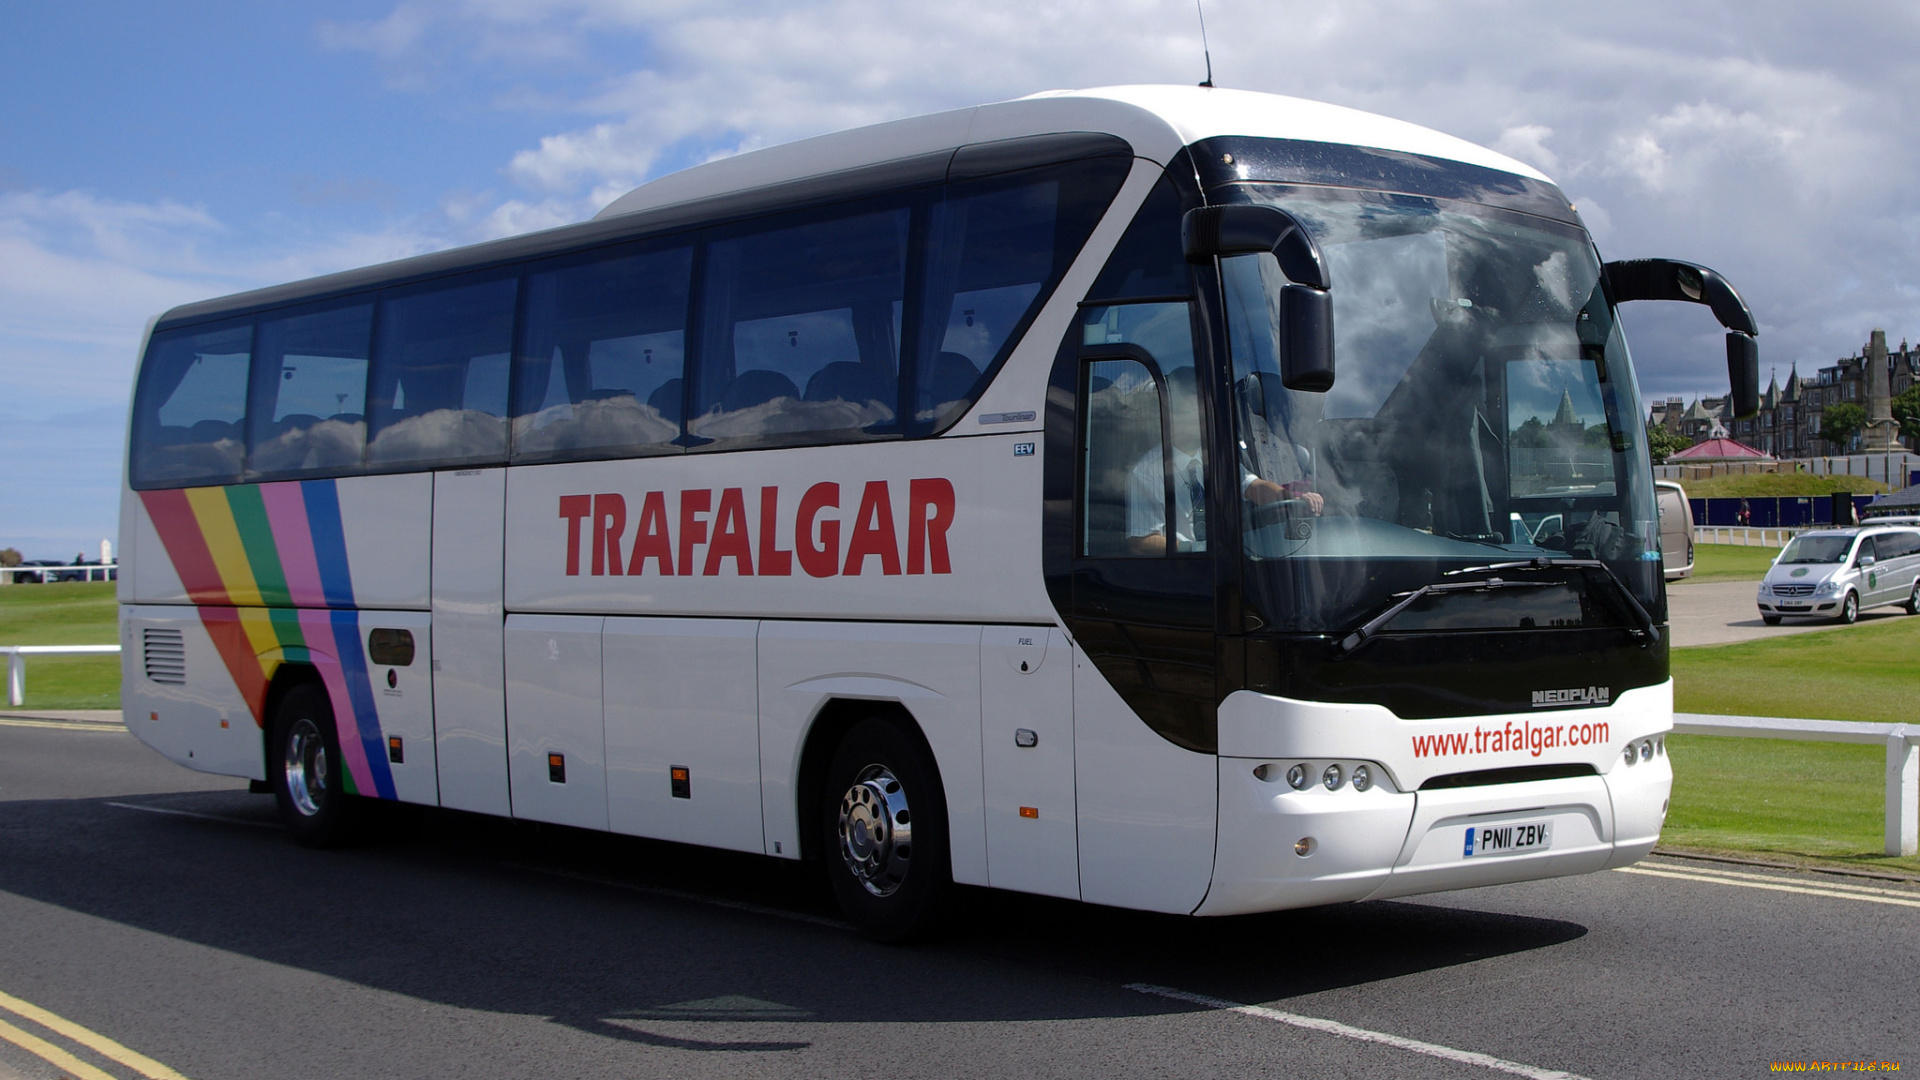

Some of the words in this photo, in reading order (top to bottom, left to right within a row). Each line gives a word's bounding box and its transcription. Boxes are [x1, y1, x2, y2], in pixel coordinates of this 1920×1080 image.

[1015, 443, 1033, 454] EEV
[559, 477, 956, 578] TRAFALGAR
[1018, 638, 1033, 646] FUEL
[1531, 686, 1610, 706] NEOPLAN
[1412, 720, 1610, 758] www.trafalgar.com
[1481, 827, 1512, 850] PN11
[1515, 824, 1546, 847] ZBV
